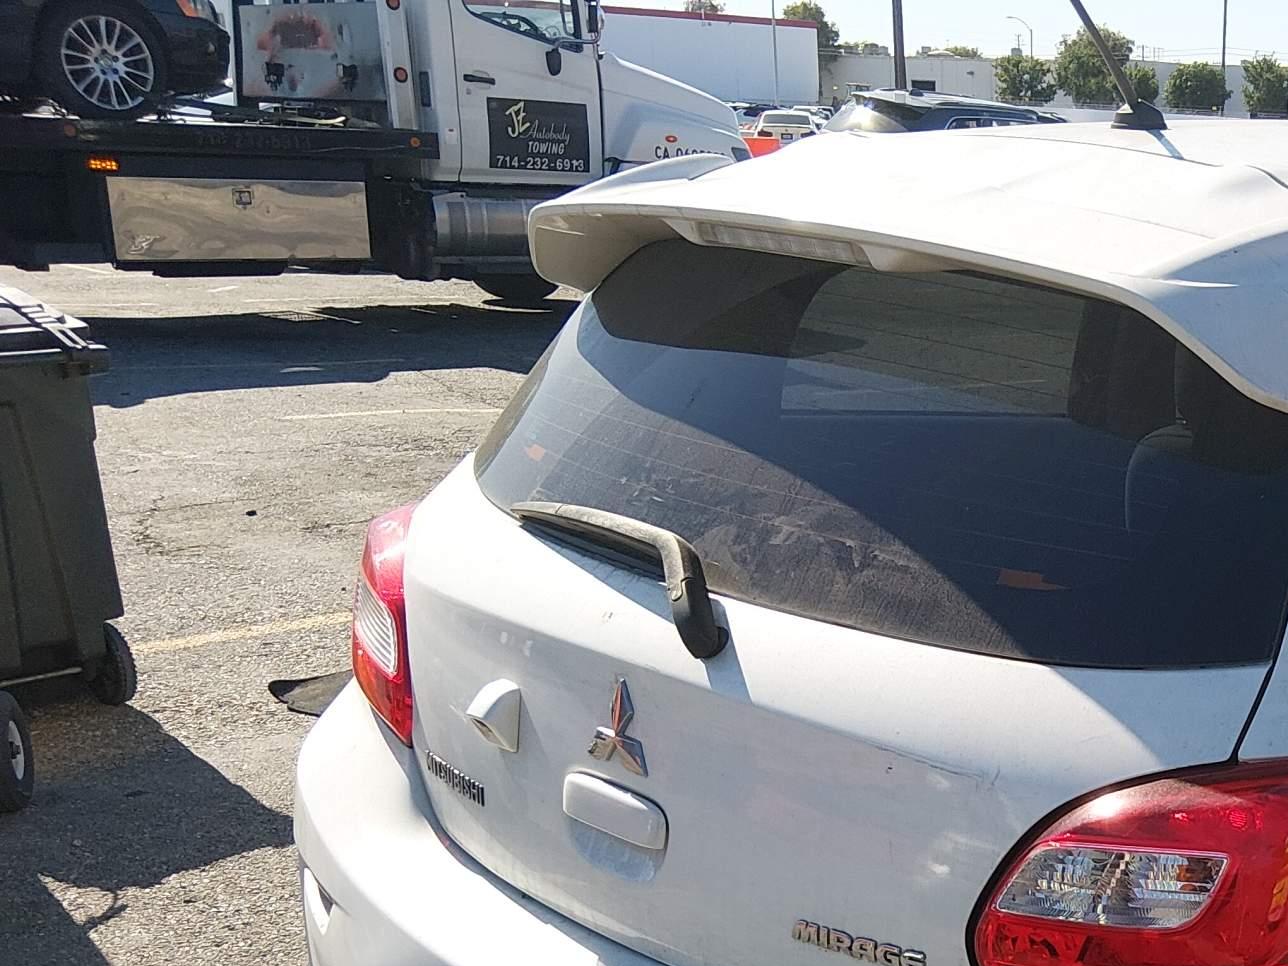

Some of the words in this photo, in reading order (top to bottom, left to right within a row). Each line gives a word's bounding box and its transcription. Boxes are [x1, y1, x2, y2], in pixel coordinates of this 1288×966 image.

[520, 119, 570, 145] Autobody
[528, 141, 565, 155] TOWING
[655, 146, 670, 159] CA
